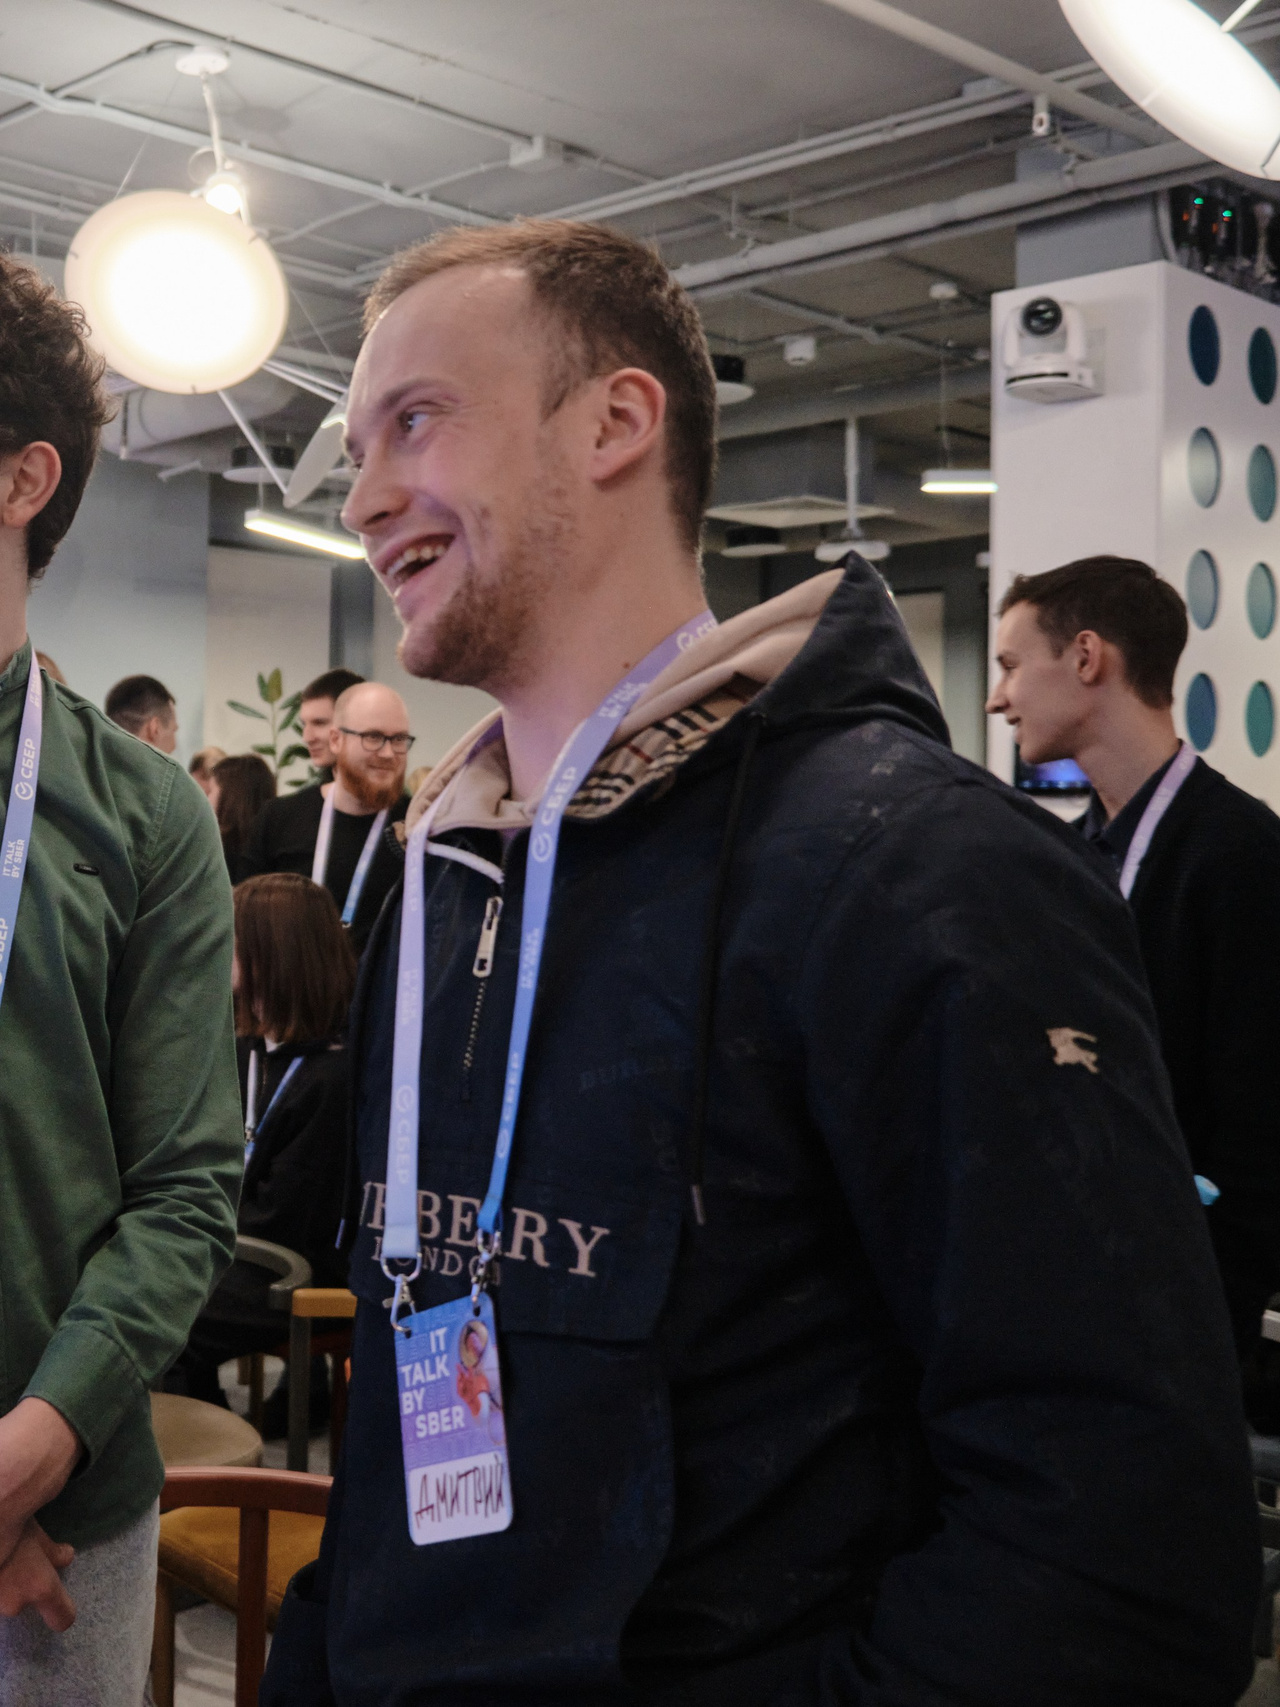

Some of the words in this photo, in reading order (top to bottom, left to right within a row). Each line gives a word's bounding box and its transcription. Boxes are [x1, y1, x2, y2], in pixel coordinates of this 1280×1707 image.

[21, 738, 36, 779] СБЕР
[542, 767, 577, 826] СБЕР
[4, 841, 16, 865] TALK
[14, 839, 26, 863] SBER
[2, 868, 10, 876] IT
[11, 864, 21, 878] BY
[396, 1119, 410, 1185] СБЕР
[430, 1327, 448, 1354] IT
[400, 1355, 450, 1388] TALK
[402, 1387, 426, 1415] BY
[416, 1405, 465, 1439] SBER
[414, 1453, 506, 1529] ДМИТРИЙ
